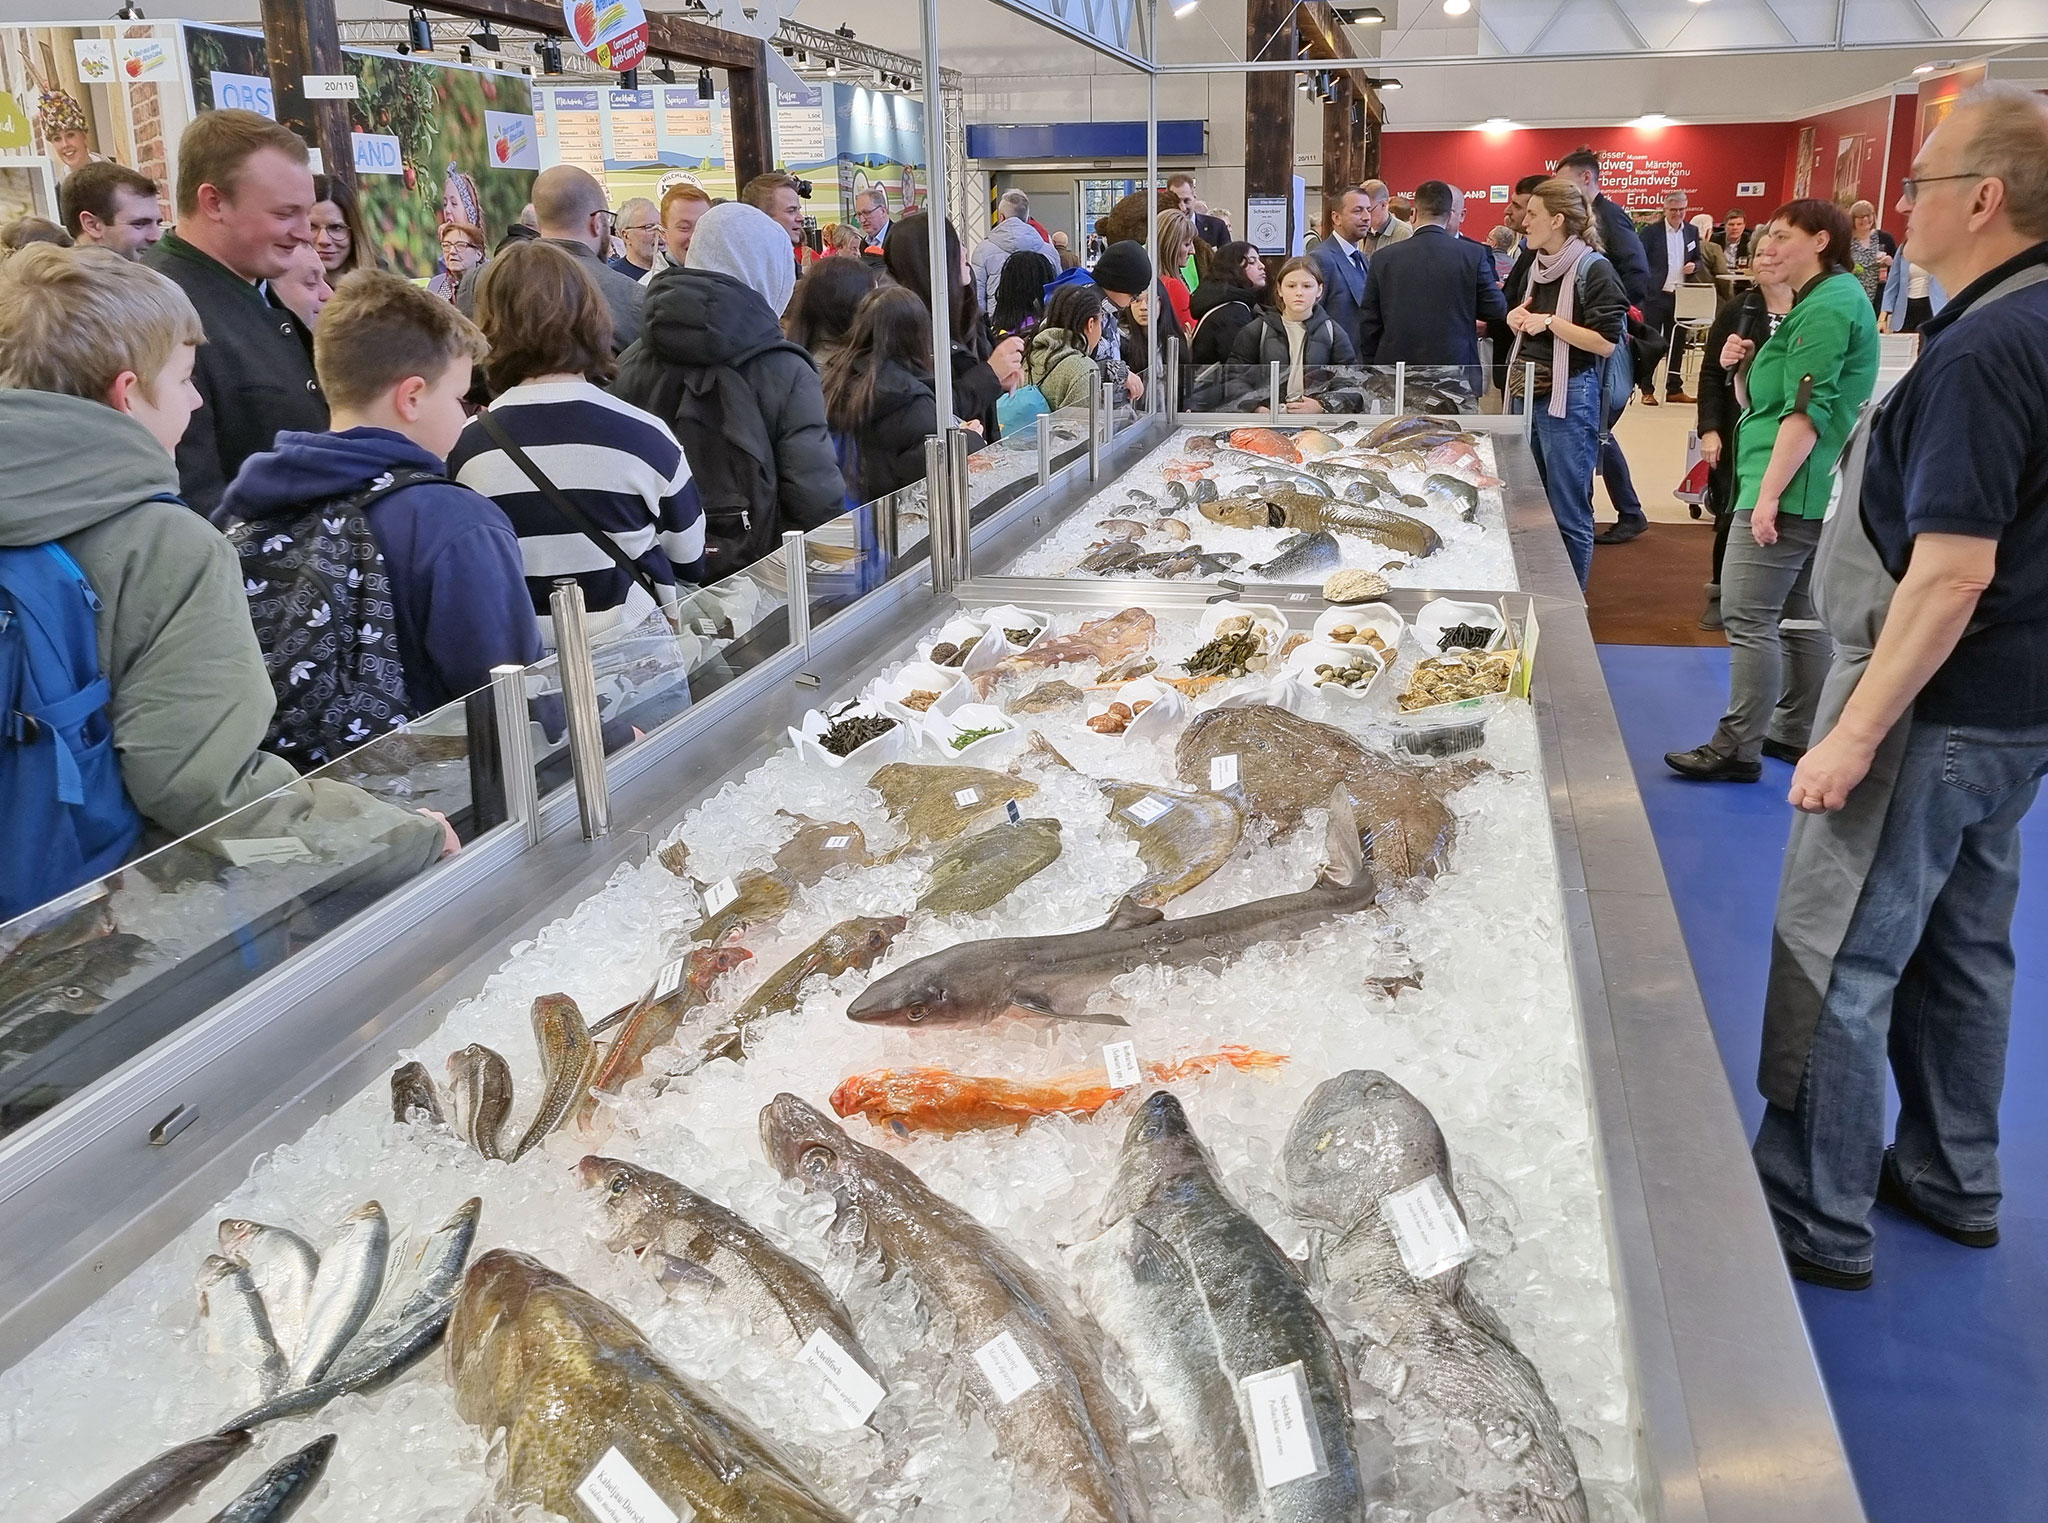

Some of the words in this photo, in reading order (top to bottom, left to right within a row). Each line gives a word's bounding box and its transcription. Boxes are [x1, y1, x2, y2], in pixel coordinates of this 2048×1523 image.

[613, 33, 633, 50] Currywurst
[612, 47, 636, 68] Apfel-Curry
[634, 40, 646, 54] Soße
[325, 82, 354, 91] 20/119
[222, 83, 273, 116] OBS
[611, 92, 637, 104] Cocktails
[666, 94, 688, 106] Speisen
[778, 89, 797, 102] Kaffee
[355, 140, 396, 167] AND
[1645, 160, 1683, 170] Märchen
[1668, 166, 1691, 177] Kanu
[661, 173, 696, 184] MILCHLAND
[814, 1345, 842, 1376] Schellfisch
[1280, 1394, 1294, 1430] Seelachs
